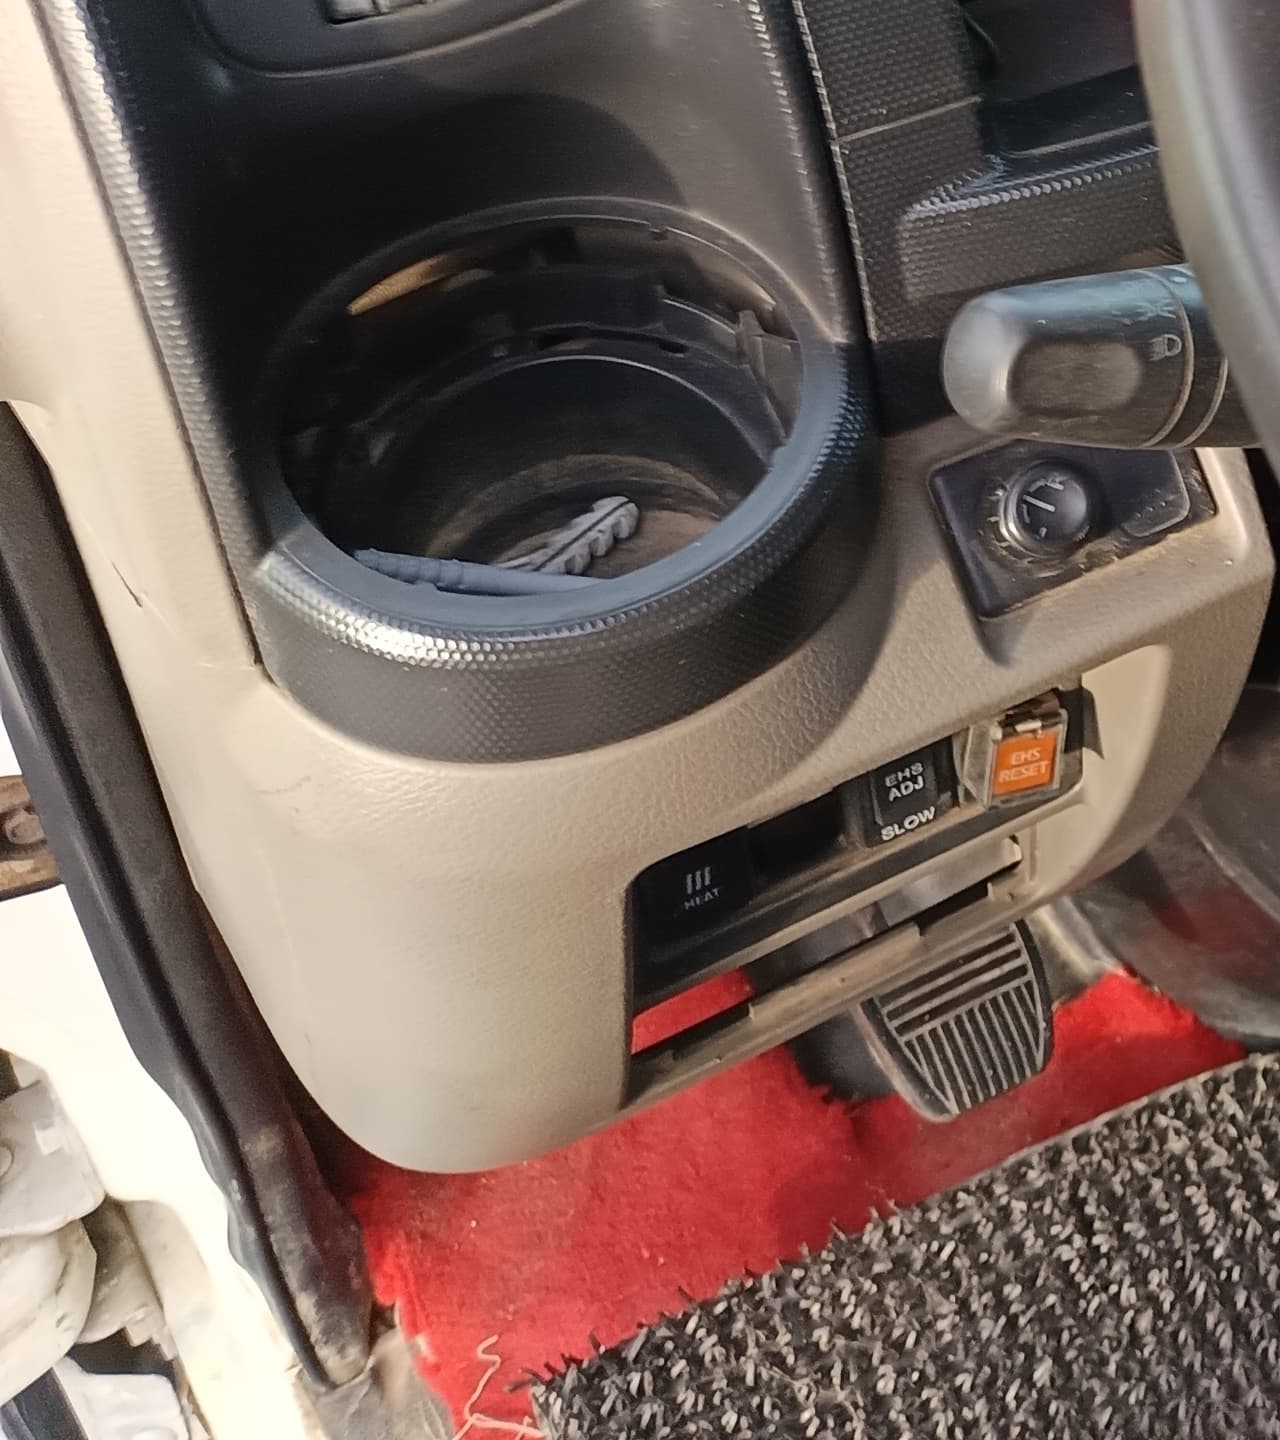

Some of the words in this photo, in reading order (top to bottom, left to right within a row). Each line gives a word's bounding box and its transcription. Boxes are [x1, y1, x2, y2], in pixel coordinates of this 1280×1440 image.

[1010, 747, 1042, 766] EHS
[884, 762, 924, 787] EHS
[999, 760, 1050, 783] RESET
[888, 775, 925, 803] ADJ
[880, 806, 936, 842] SLOW
